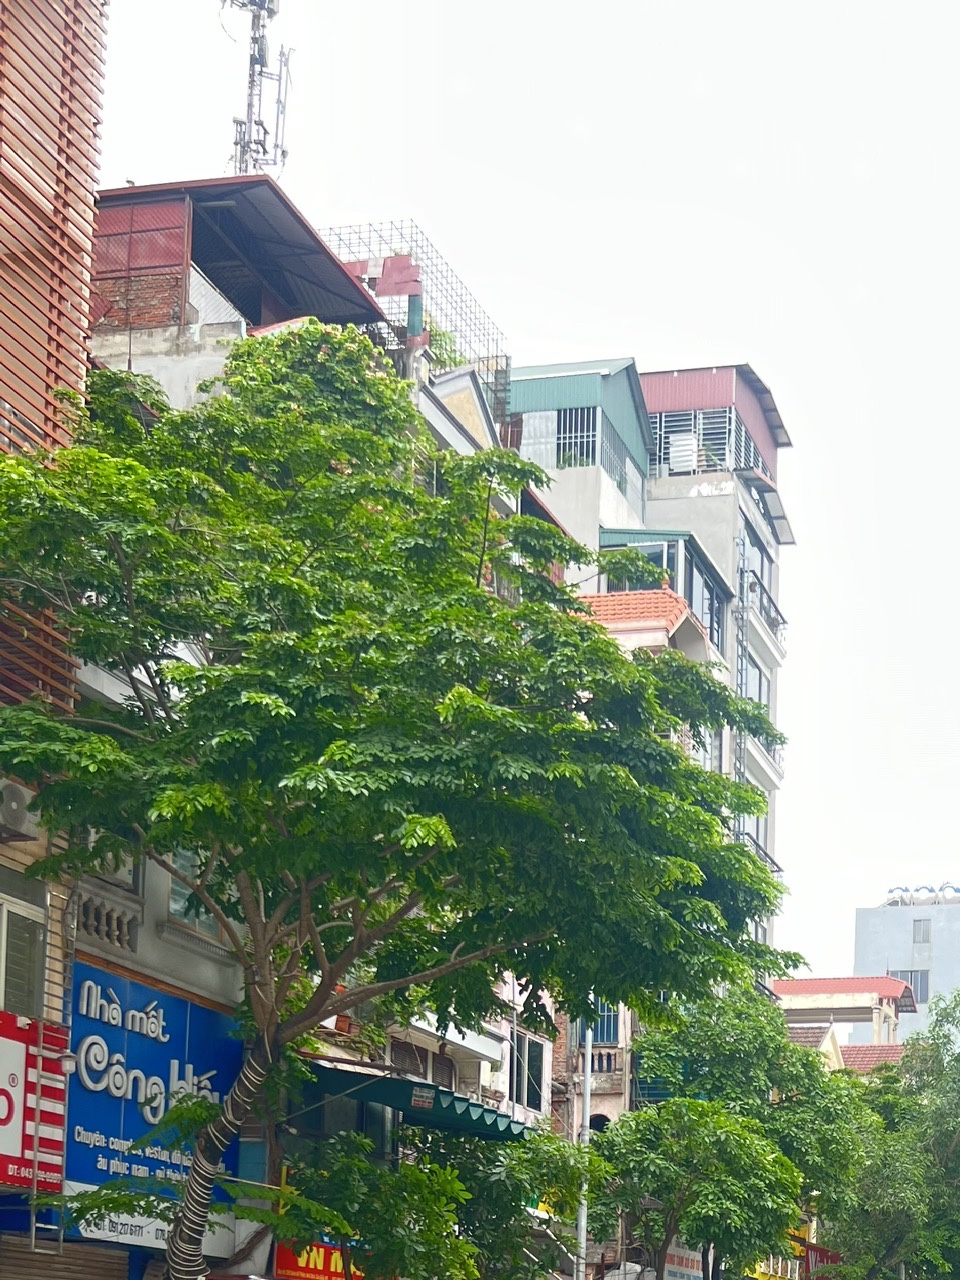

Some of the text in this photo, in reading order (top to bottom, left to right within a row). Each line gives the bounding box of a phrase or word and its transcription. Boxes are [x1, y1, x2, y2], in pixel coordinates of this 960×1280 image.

[79, 980, 170, 1043] Nhà mốt
[77, 1035, 166, 1124] Công
[74, 1125, 107, 1149] Chuyên:
[109, 1157, 130, 1177] phục
[131, 1164, 149, 1178] nam
